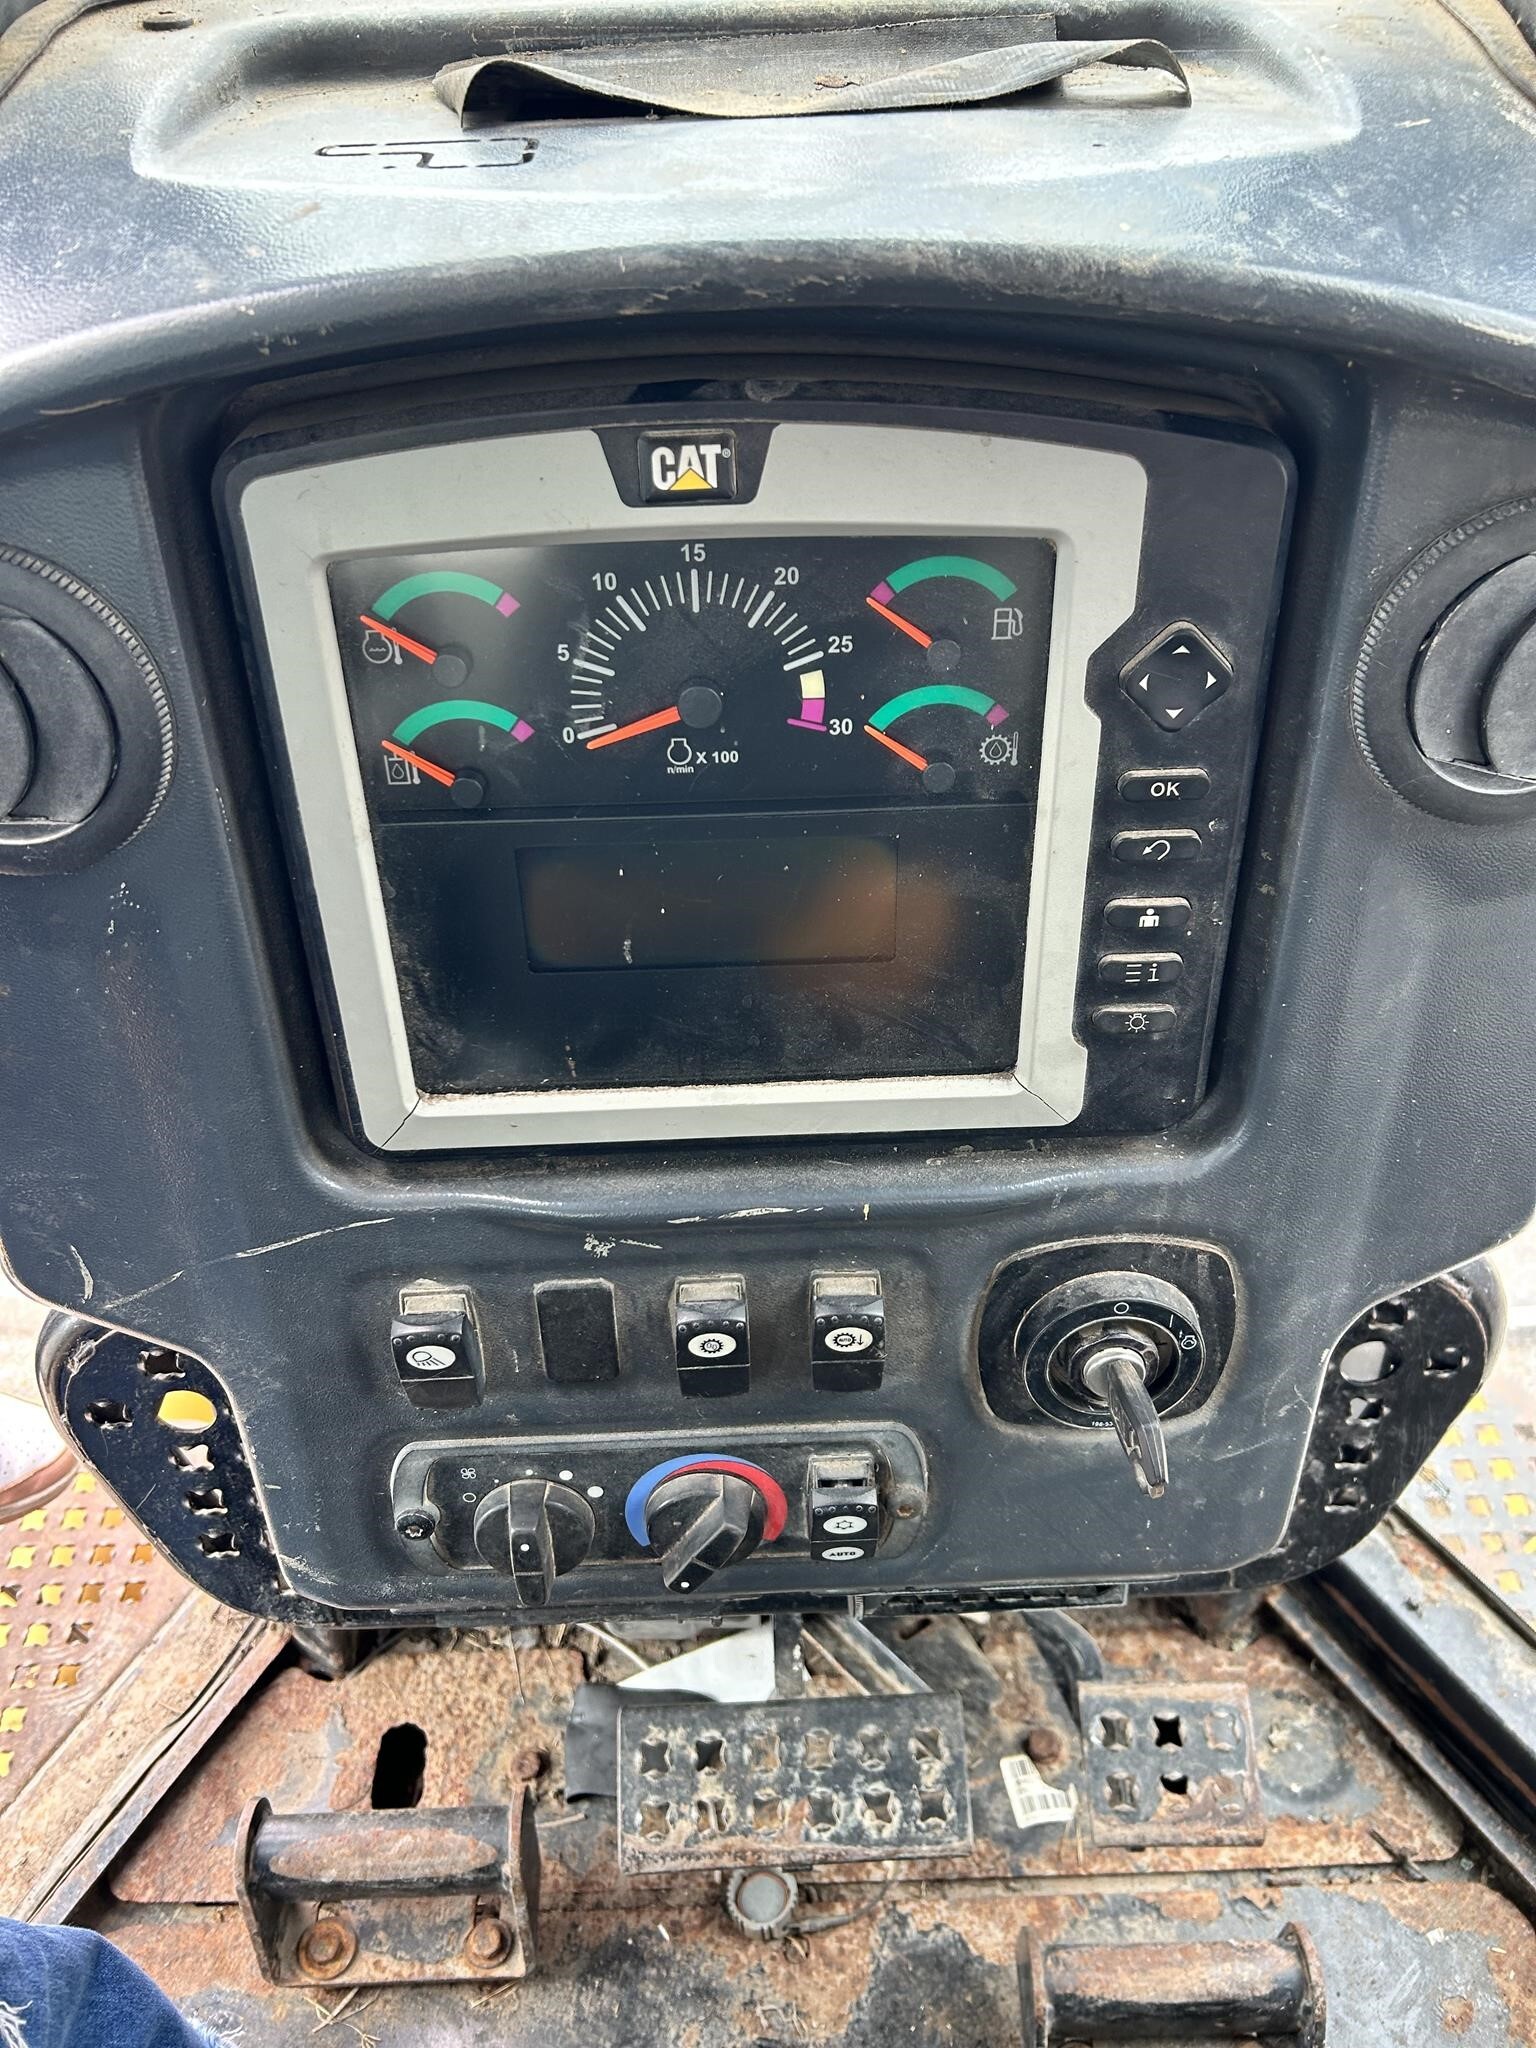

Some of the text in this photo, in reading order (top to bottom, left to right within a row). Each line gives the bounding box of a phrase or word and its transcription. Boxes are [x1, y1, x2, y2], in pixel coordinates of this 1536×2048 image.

[681, 543, 706, 562] 15
[592, 572, 618, 591] 10
[773, 567, 800, 586] 20
[557, 645, 570, 661] 5
[827, 635, 854, 654] 25
[563, 727, 575, 744] 0
[829, 719, 853, 736] 30
[711, 750, 739, 764] 100
[666, 765, 695, 775] n/min
[1150, 782, 1181, 798] OK
